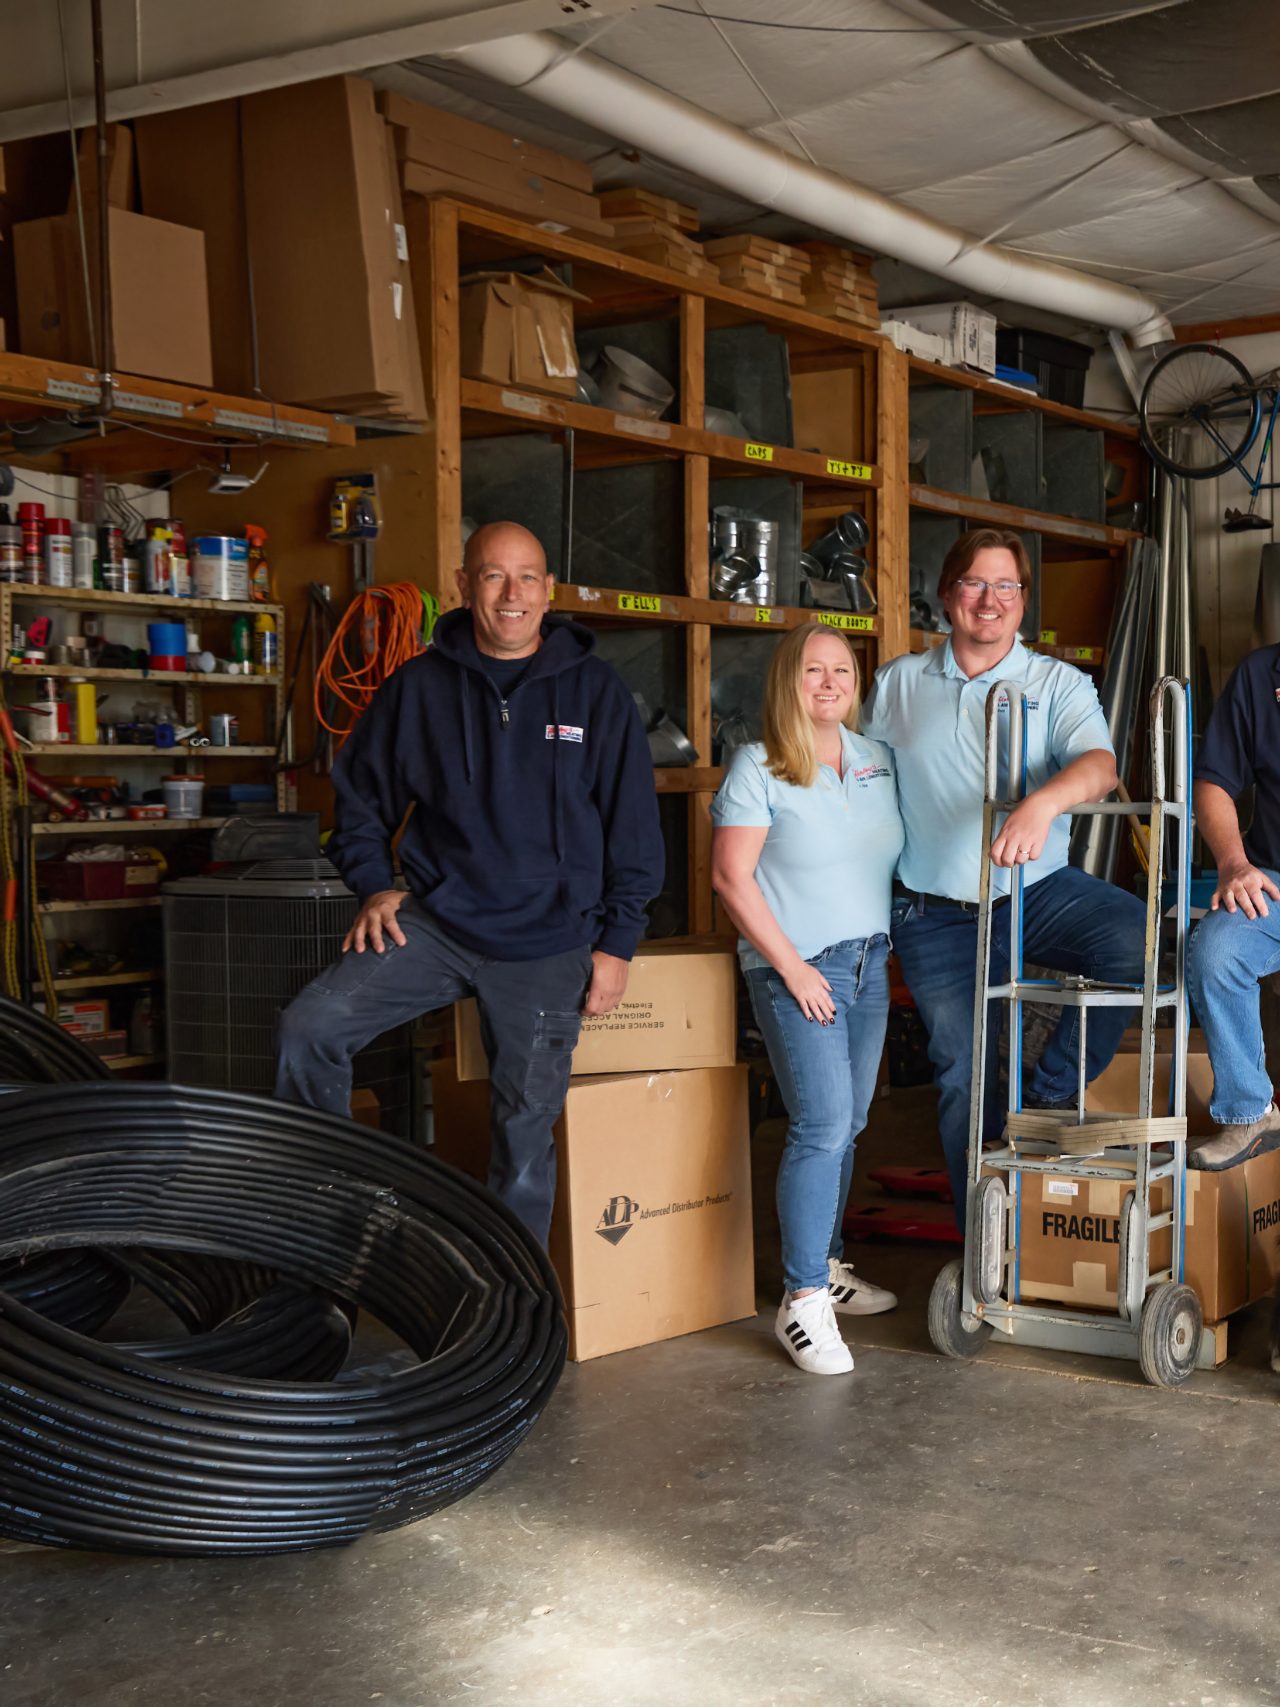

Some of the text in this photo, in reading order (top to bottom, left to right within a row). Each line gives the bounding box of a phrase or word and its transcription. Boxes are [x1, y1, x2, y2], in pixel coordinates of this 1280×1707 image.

[747, 446, 768, 460] CAPS
[820, 614, 869, 630] STACK BOOTS
[627, 1021, 665, 1030] SERVICE
[640, 1204, 671, 1221] Advanced
[672, 1200, 704, 1214] Distributor
